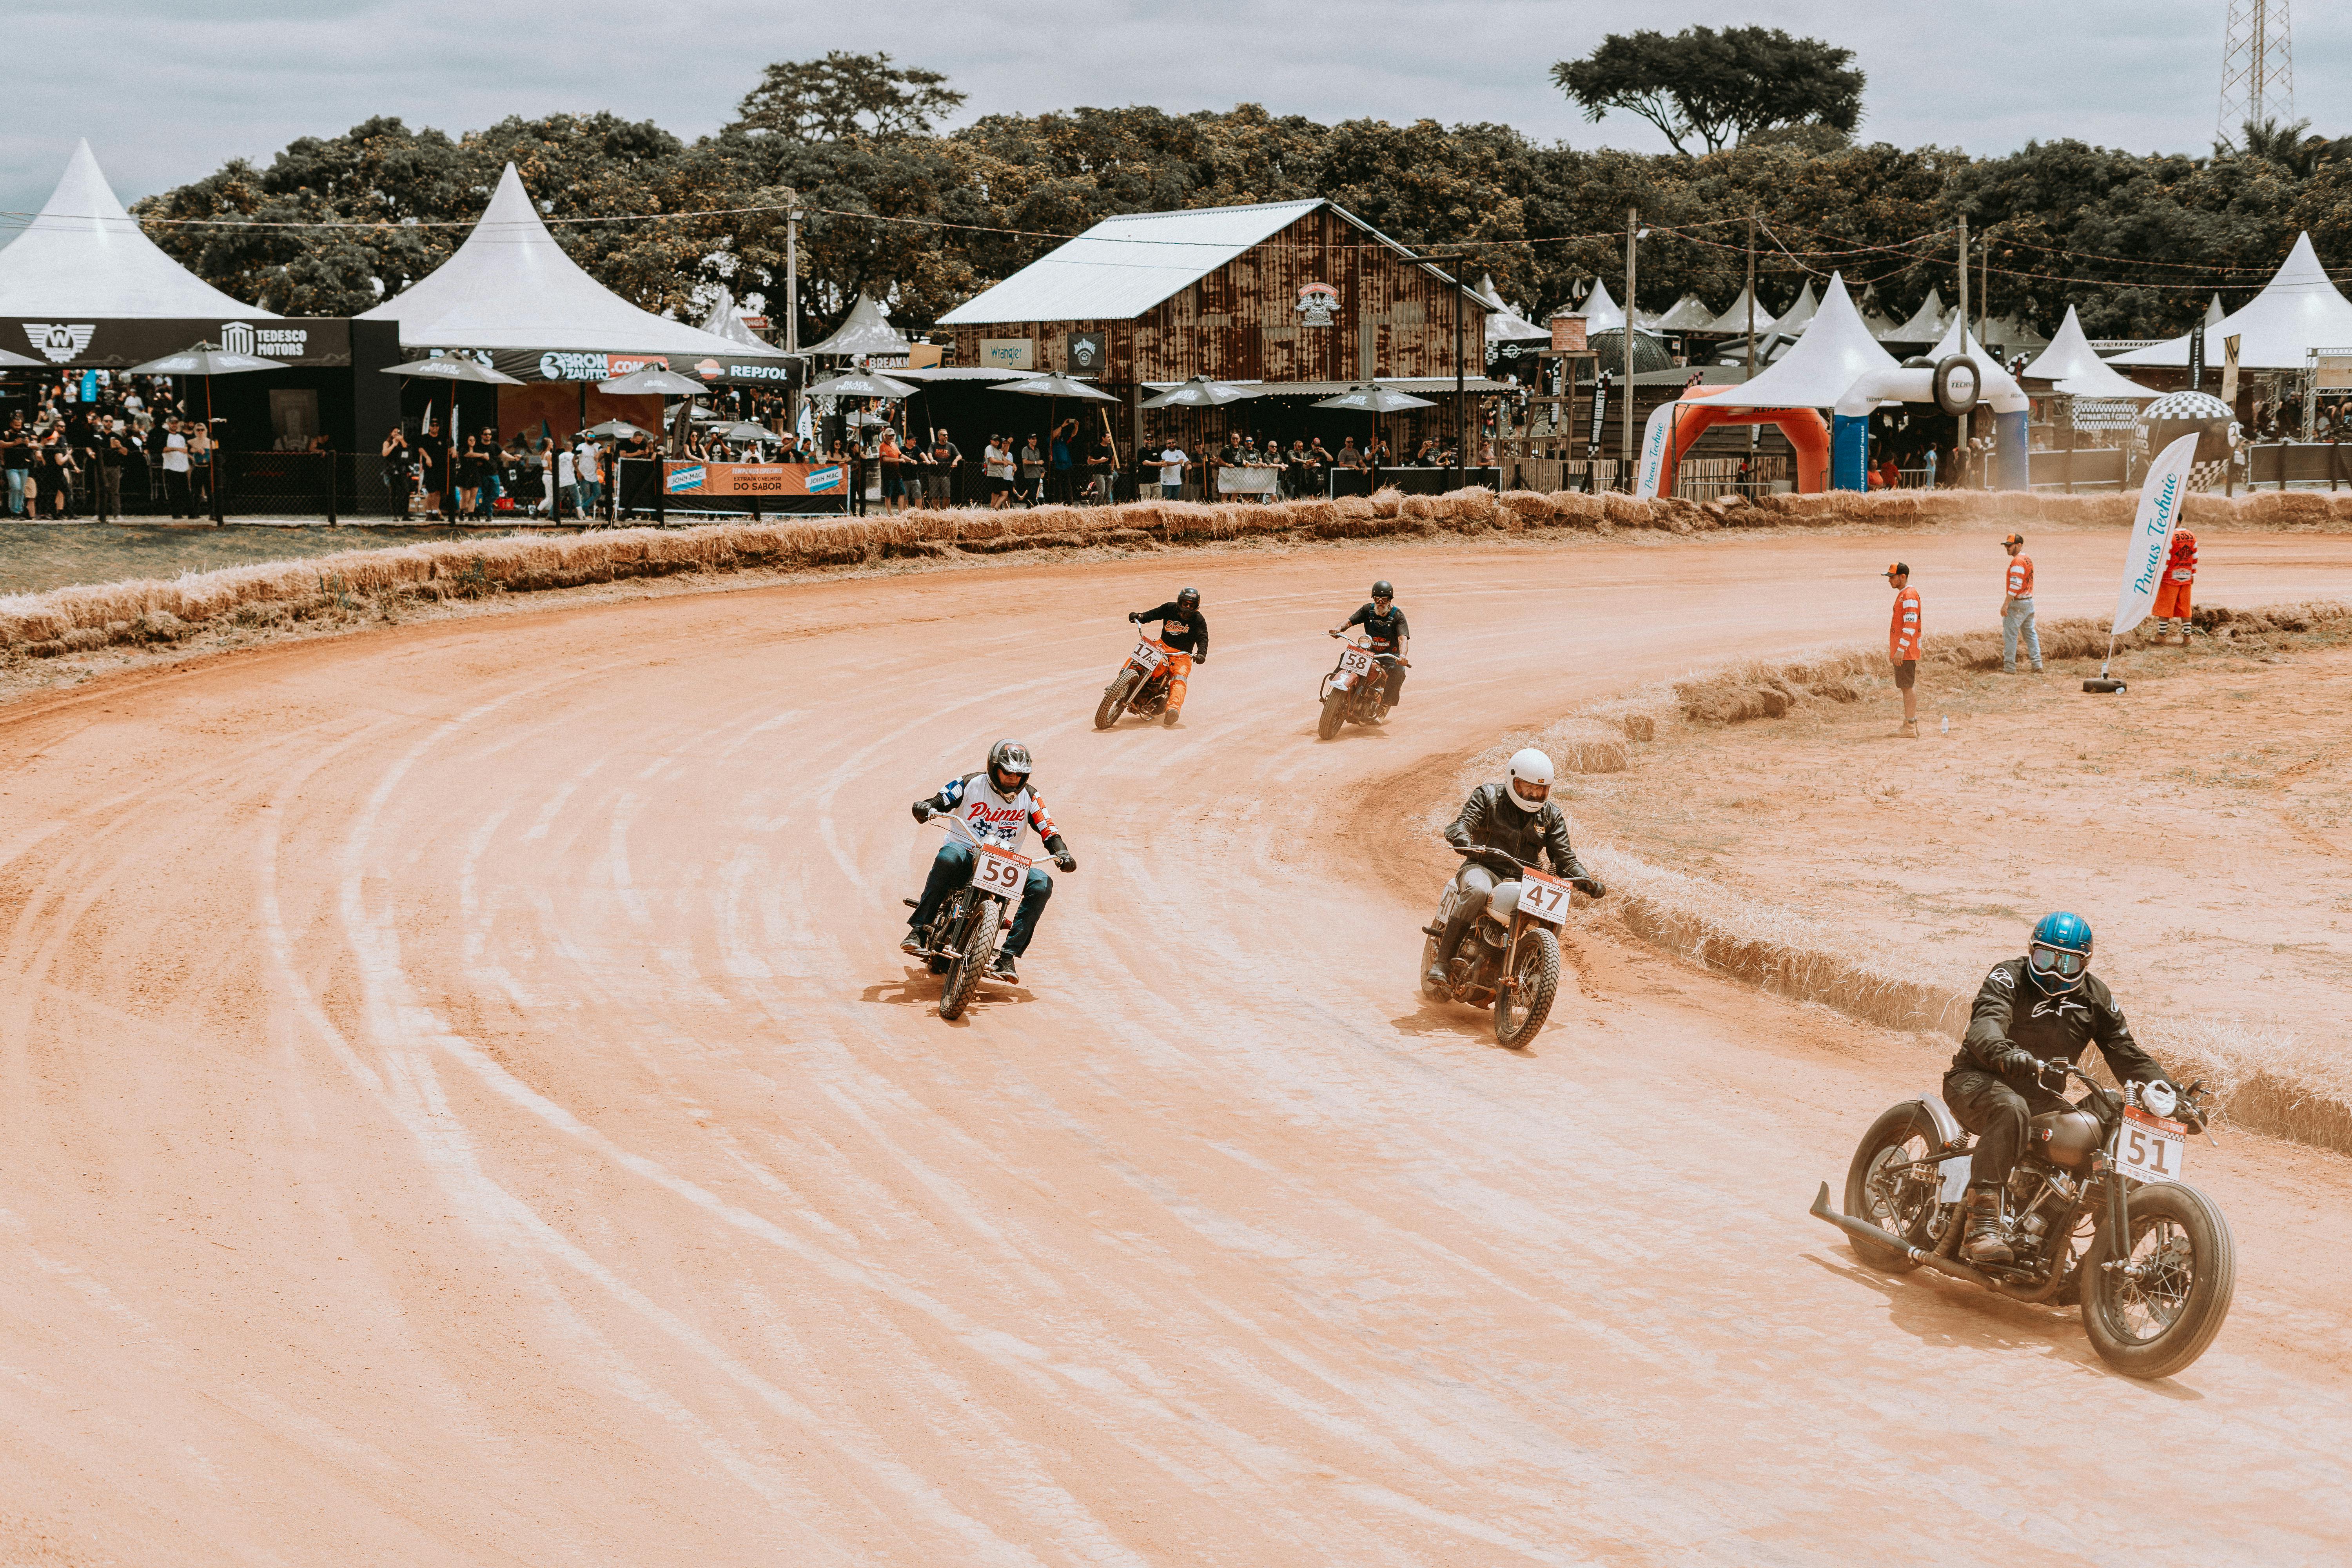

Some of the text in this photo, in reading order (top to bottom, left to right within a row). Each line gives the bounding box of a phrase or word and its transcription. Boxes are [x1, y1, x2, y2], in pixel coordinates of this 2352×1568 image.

[256, 330, 307, 342] TEDESCO
[257, 343, 304, 356] MOTORS
[990, 345, 1023, 366] Wrangler
[566, 369, 610, 380] ZAUTTO
[730, 365, 788, 380] REPSOL
[1592, 390, 1606, 443] URBAN HELMETS
[1644, 422, 1664, 490] Pneus Technic
[671, 472, 702, 484] JOHN MAC
[809, 472, 839, 485] JOHN MAC
[2134, 472, 2177, 595] Pneus Technic
[1346, 653, 1367, 670] 58
[967, 802, 1025, 822] Prime
[1012, 854, 1031, 865] FLAT-TRACK
[983, 859, 1018, 888] 59
[1553, 878, 1571, 888] FLAT-TRACK
[1526, 885, 1563, 911] 47
[2127, 1129, 2169, 1175] 51
